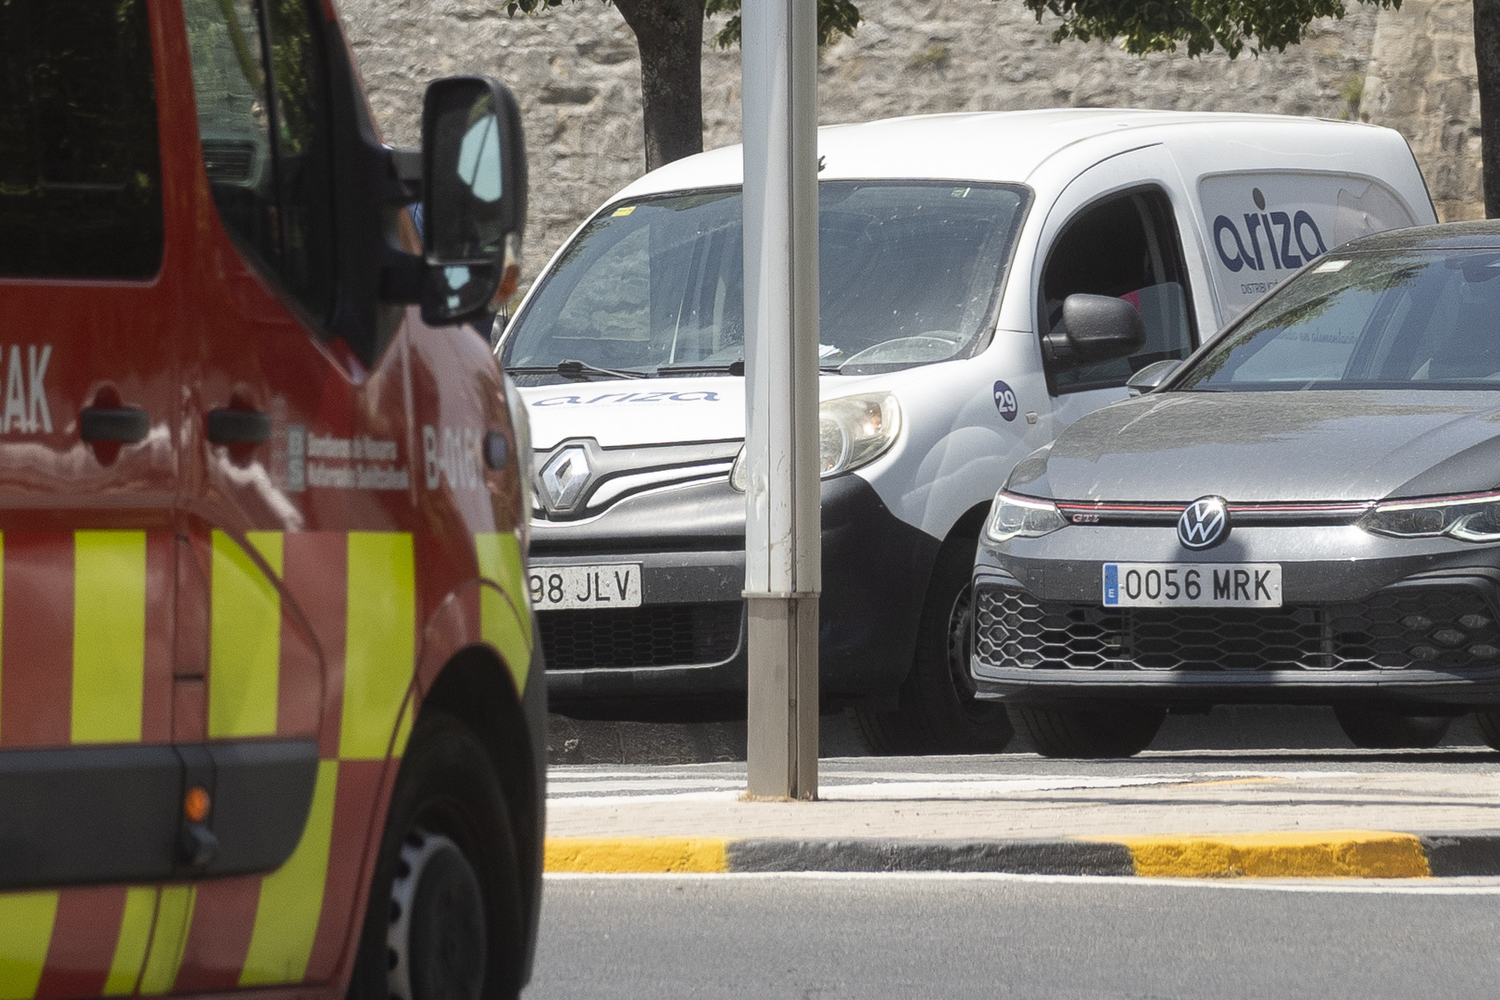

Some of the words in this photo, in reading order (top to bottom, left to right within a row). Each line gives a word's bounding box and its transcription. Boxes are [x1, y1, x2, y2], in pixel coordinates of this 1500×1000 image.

[1213, 187, 1328, 273] ariza
[531, 391, 721, 407] ariza
[995, 390, 1017, 413] 29
[529, 573, 564, 604] 98
[576, 570, 631, 603] JLV
[1125, 569, 1202, 600] 0056
[1213, 569, 1272, 601] MRK
